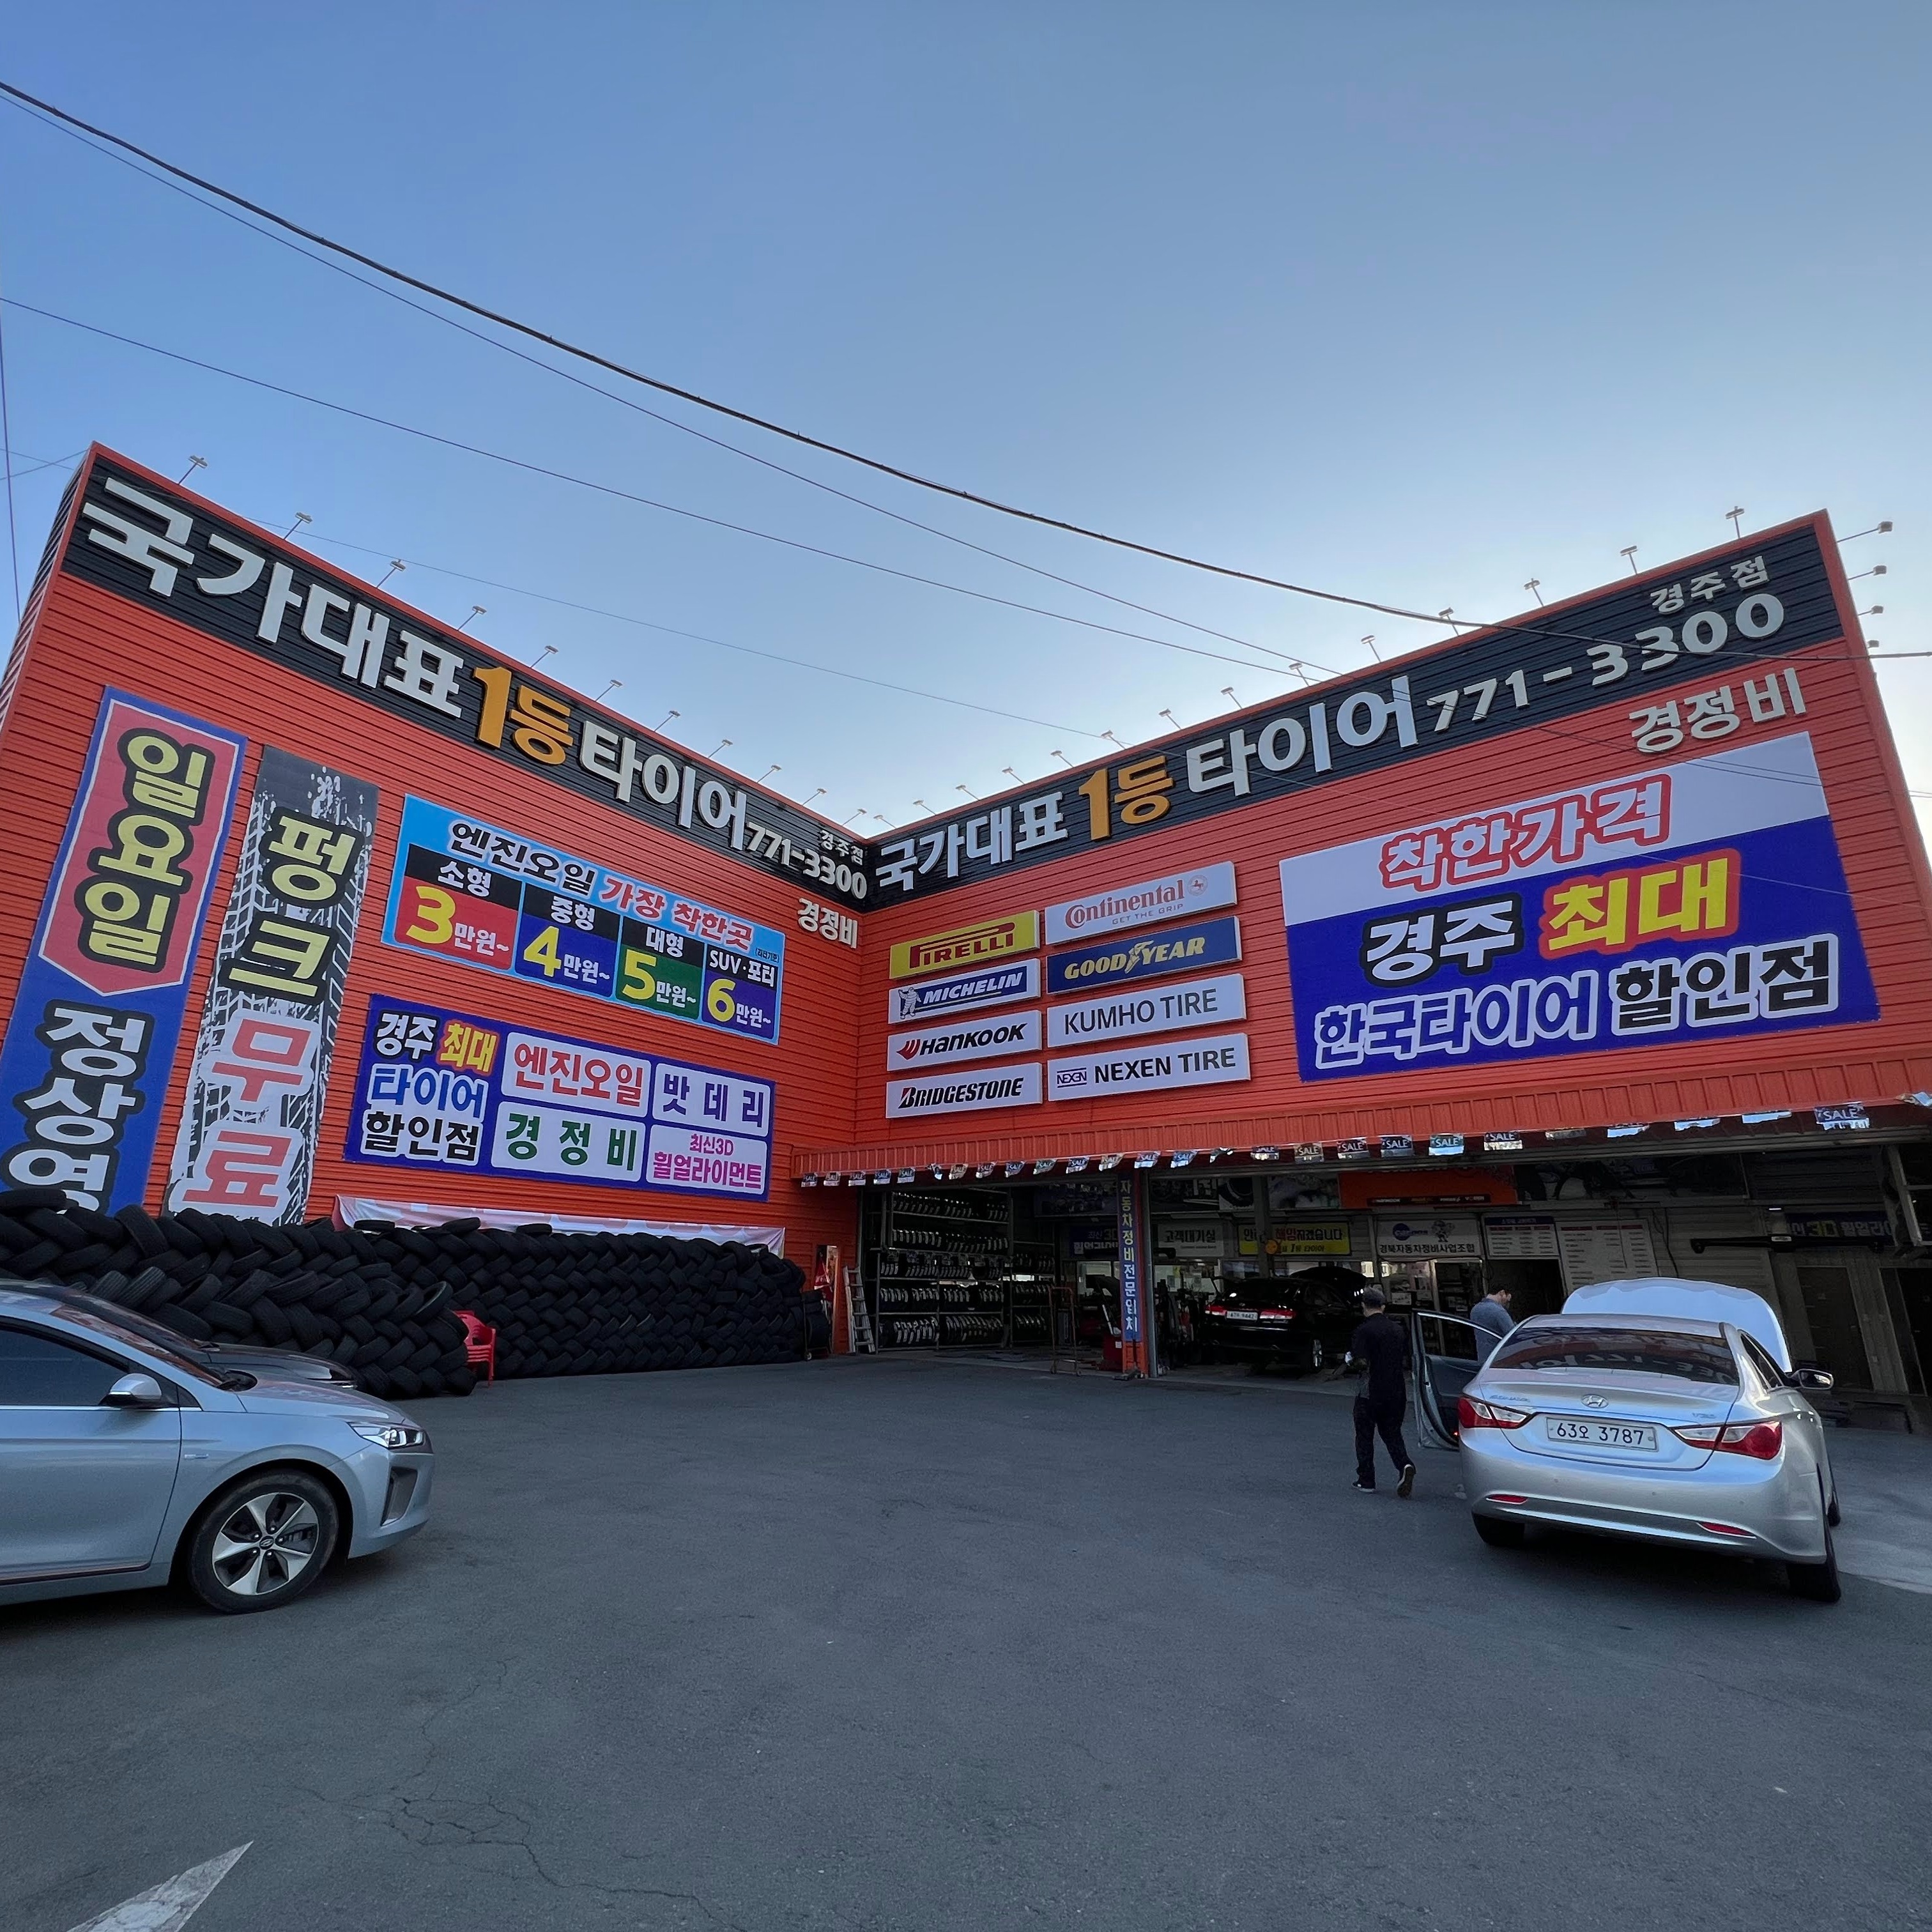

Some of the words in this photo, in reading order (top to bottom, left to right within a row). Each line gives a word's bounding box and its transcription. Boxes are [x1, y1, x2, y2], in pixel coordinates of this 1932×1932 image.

[1650, 556, 1770, 615] 경주점
[82, 477, 464, 719] 국가대표
[473, 666, 574, 765] 1등
[579, 720, 747, 850] 타이어
[1427, 593, 1784, 732] 771-3300
[1629, 668, 1807, 754] 경정비
[875, 790, 1068, 893] 국가대표
[1078, 755, 1174, 843] 1등
[1186, 675, 1419, 796] 타이어
[84, 735, 208, 967] 일요일
[746, 822, 867, 900] 771-3300
[820, 829, 863, 866] 경주점
[437, 861, 491, 896] 소형
[451, 822, 595, 896] 엔진오일
[602, 877, 666, 920] 가장
[671, 902, 754, 951] 착한곳
[230, 816, 355, 997] 펑크
[550, 896, 595, 931] 중형
[798, 898, 858, 949] 경정비
[1065, 879, 1185, 929] Continental
[1112, 916, 1131, 925] GET
[1135, 910, 1153, 919] THE
[1158, 903, 1183, 914] GRIP
[1366, 900, 1515, 980] 경주
[1548, 857, 1729, 951] 최대
[645, 926, 684, 958] 대형
[909, 922, 1015, 969] PIRELLI
[1064, 936, 1206, 980] GOODYEAR
[923, 972, 1023, 1004] MICHELIN
[1064, 1000, 1154, 1035] KUMHO
[1161, 988, 1218, 1020] TIRE
[1319, 975, 1595, 1063] 한국타이어
[1615, 940, 1832, 1030] 할인점
[376, 1013, 437, 1059] 경주
[441, 1022, 497, 1073] 최대
[1056, 1070, 1087, 1085] NEXEN
[1094, 1055, 1171, 1084] NEXEN
[1177, 1048, 1236, 1073] TIRE
[372, 1066, 484, 1117] 타이어
[514, 1042, 643, 1106] 엔진오일
[898, 1077, 1024, 1109] BRIDGESTONE
[184, 1018, 311, 1207] 무료
[366, 1111, 479, 1161] 할인점
[1822, 1108, 1859, 1121] SALE
[689, 1133, 734, 1156] 최신3D
[1298, 1146, 1320, 1156] SALE
[1342, 1141, 1364, 1152] SALE
[1386, 1138, 1408, 1149] SALE
[1435, 1137, 1459, 1147] SALE
[1491, 1133, 1514, 1142] SALE
[653, 1151, 762, 1190] 휠얼라이먼트
[1164, 1229, 1216, 1243] 고객대기실
[1556, 1422, 1590, 1439] 63오
[1598, 1425, 1644, 1445] 3787
